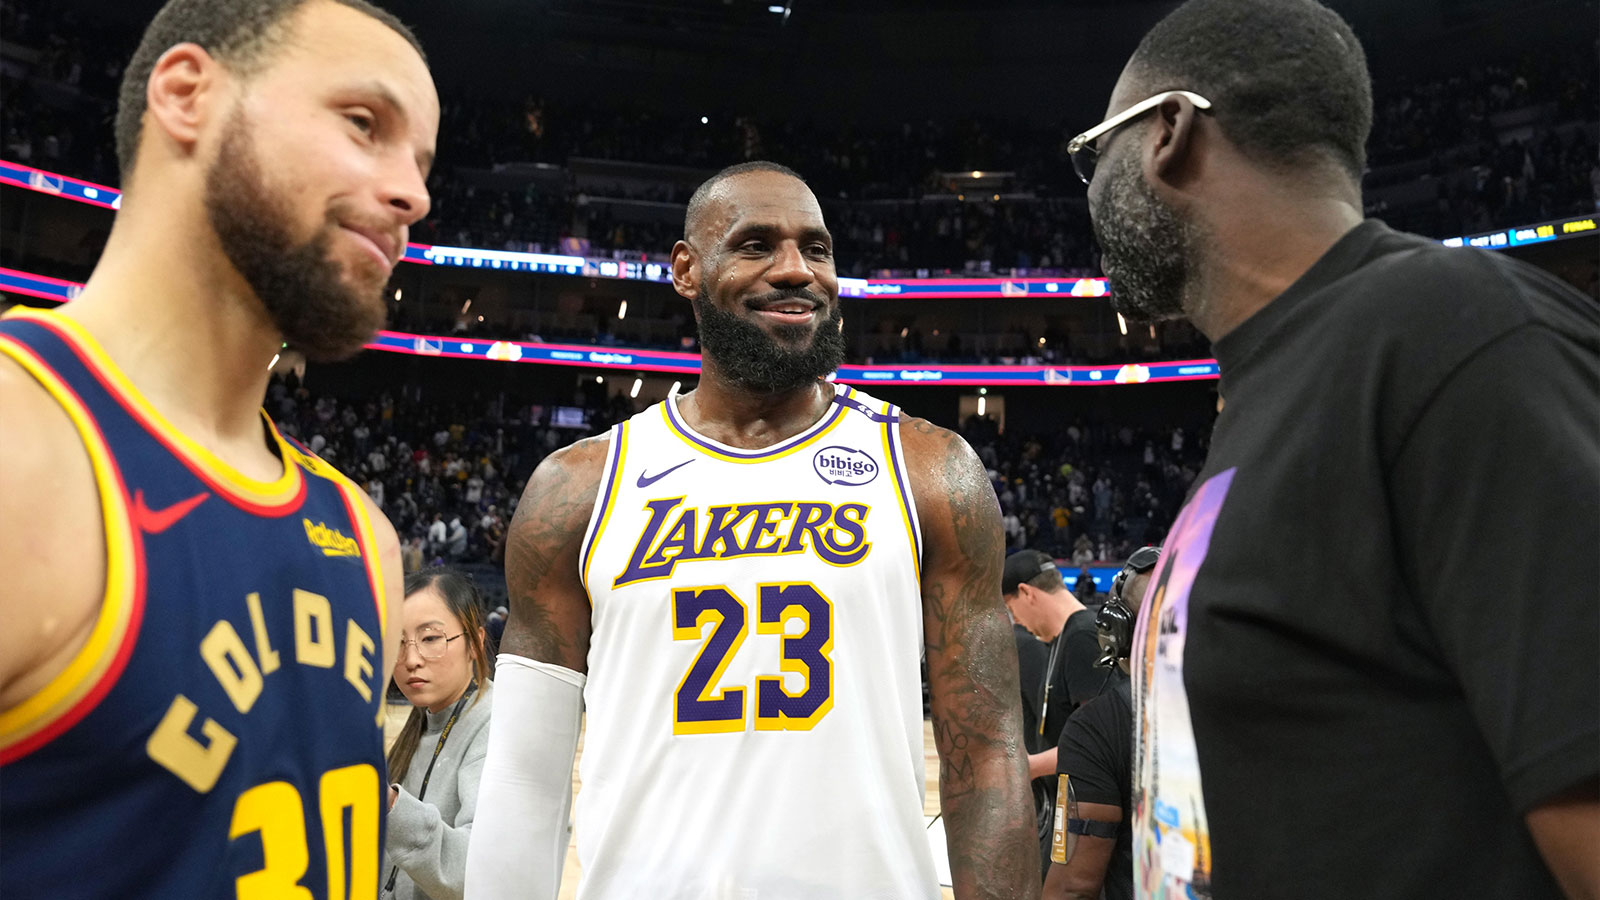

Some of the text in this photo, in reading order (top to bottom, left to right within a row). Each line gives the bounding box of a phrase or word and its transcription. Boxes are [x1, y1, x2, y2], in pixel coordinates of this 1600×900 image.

[819, 455, 874, 475] bibigo
[611, 495, 872, 590] LAKERS
[146, 588, 386, 794] GOLDE
[671, 581, 834, 735] 23
[228, 764, 380, 900] 30
